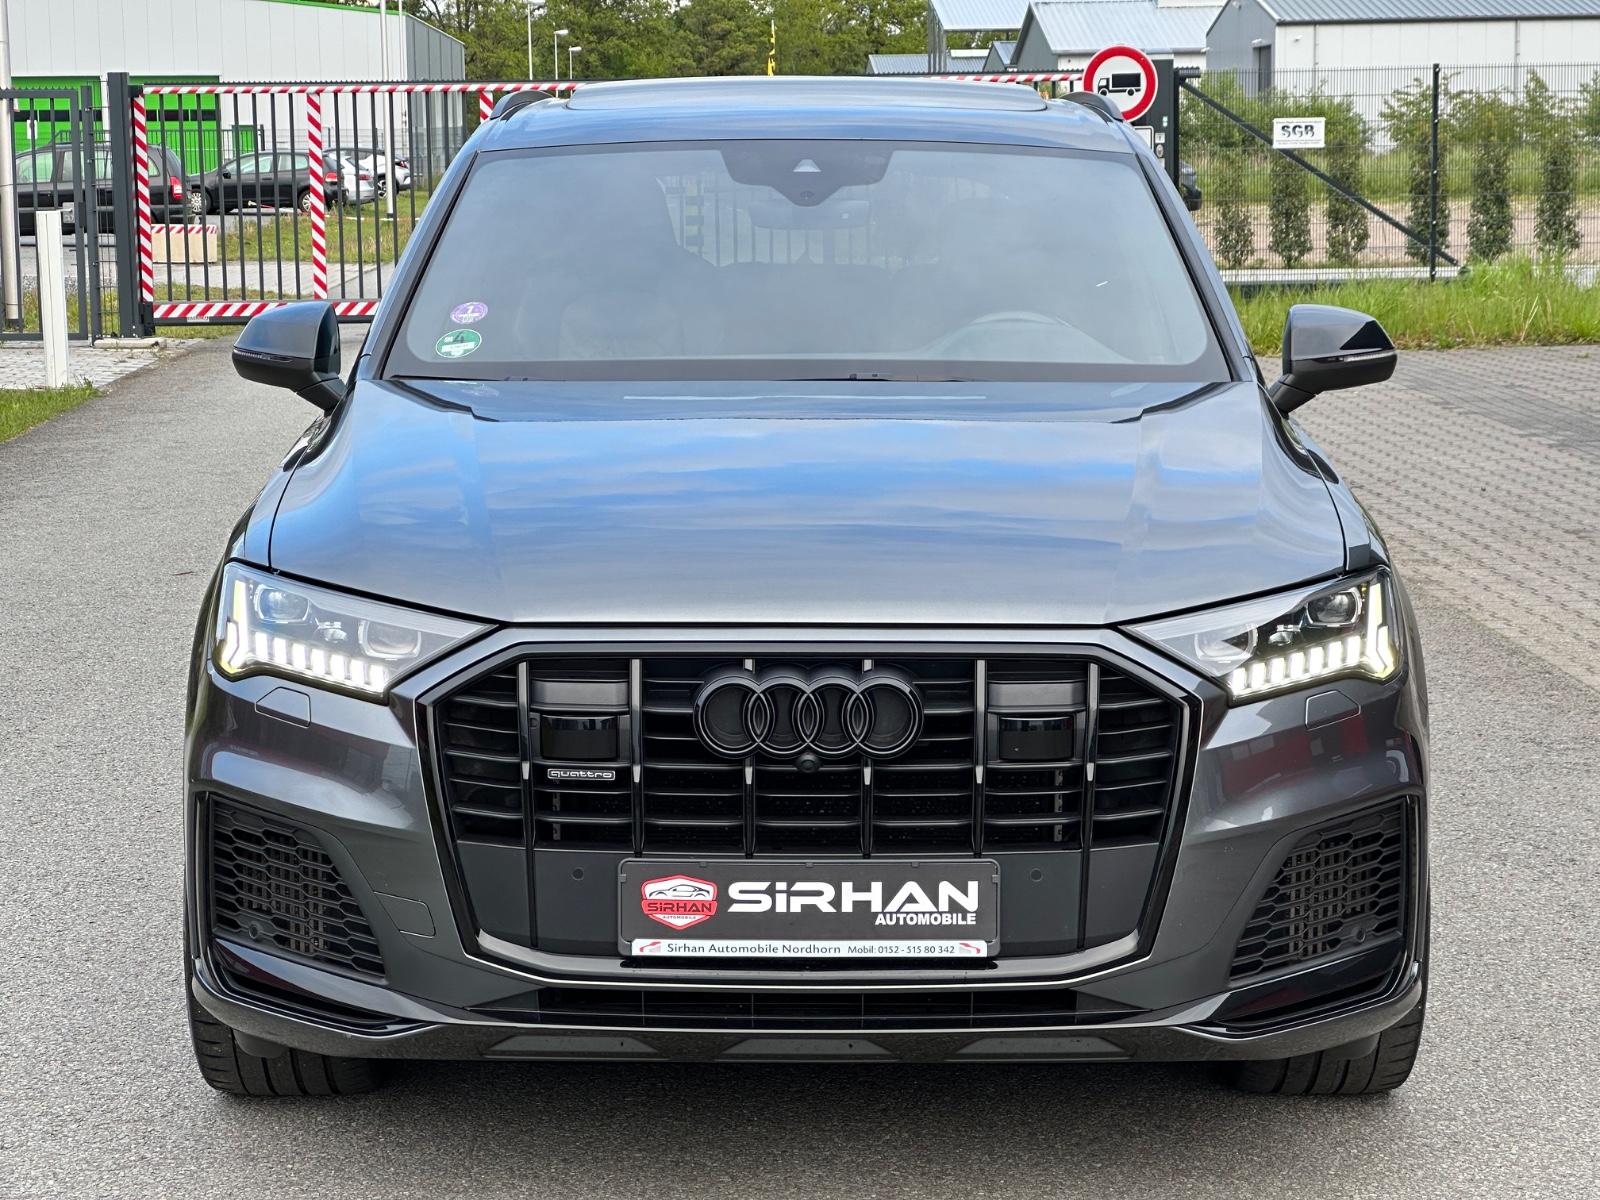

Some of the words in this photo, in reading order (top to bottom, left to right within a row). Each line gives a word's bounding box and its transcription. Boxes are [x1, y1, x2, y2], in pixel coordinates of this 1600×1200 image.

[550, 770, 613, 779] quattro
[874, 912, 977, 926] AUTOMOBILE
[667, 943, 705, 953] Sirhan
[708, 943, 779, 954] Automobile
[782, 943, 841, 954] Nordhorn
[847, 945, 877, 954] Mobil:
[877, 945, 899, 954] 0152
[906, 945, 924, 954] 515
[924, 945, 936, 954] 80
[938, 945, 955, 954] 342
